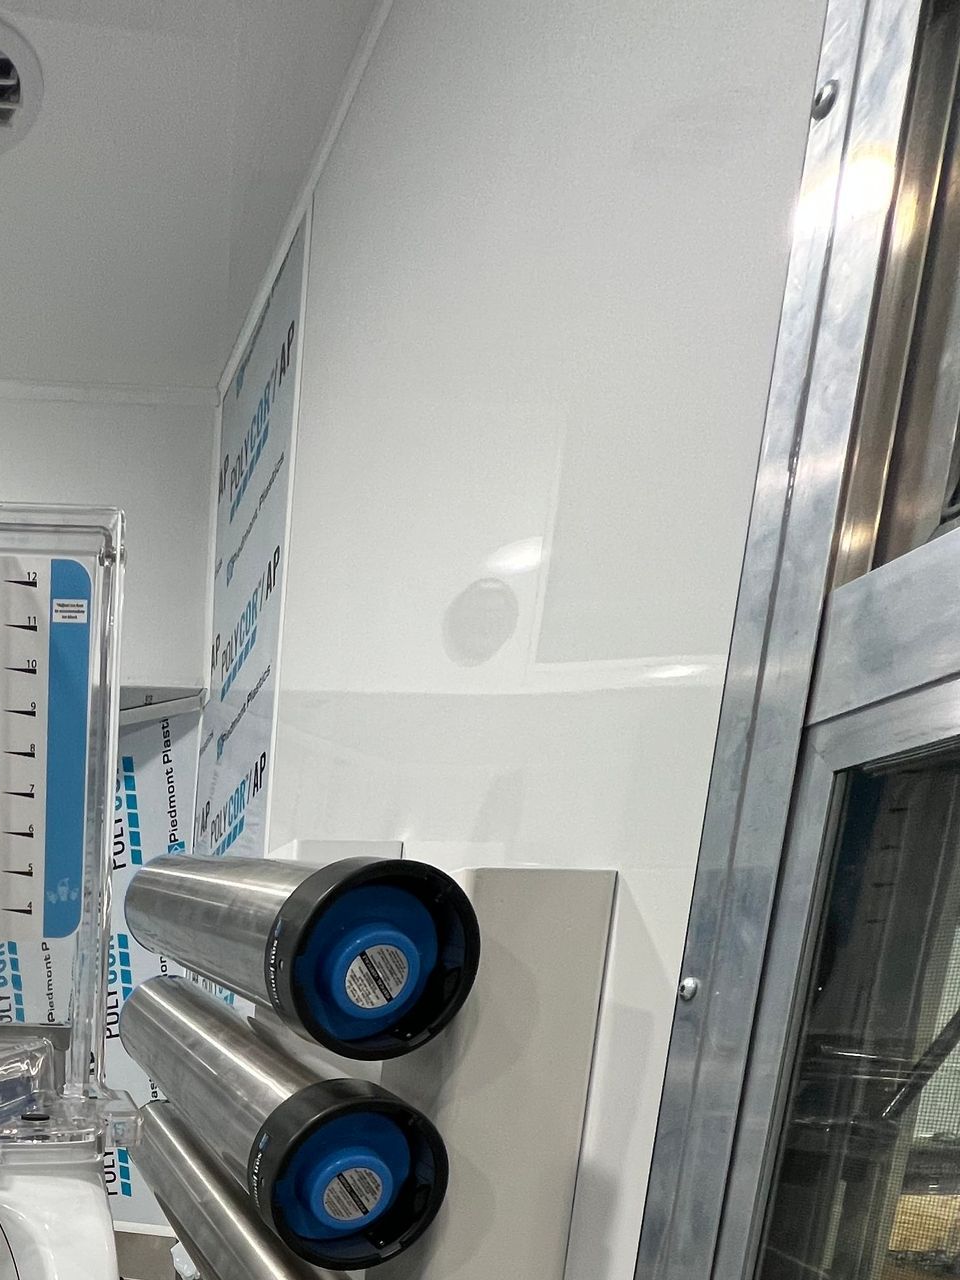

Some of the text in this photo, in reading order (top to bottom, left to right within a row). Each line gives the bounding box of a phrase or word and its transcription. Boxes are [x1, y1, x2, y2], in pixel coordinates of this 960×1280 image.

[279, 320, 295, 387] AP
[27, 572, 37, 581] 12
[266, 545, 280, 600] AP
[27, 616, 37, 625] 11
[27, 659, 37, 669] 10
[30, 702, 36, 711] 9
[30, 744, 36, 753] 8
[253, 751, 267, 798] AP
[29, 784, 35, 793] 7
[168, 768, 178, 843] Piedmont
[28, 824, 34, 833] 6
[28, 863, 33, 872] 5
[27, 901, 33, 910] 4
[42, 954, 55, 1023] Piedmont
